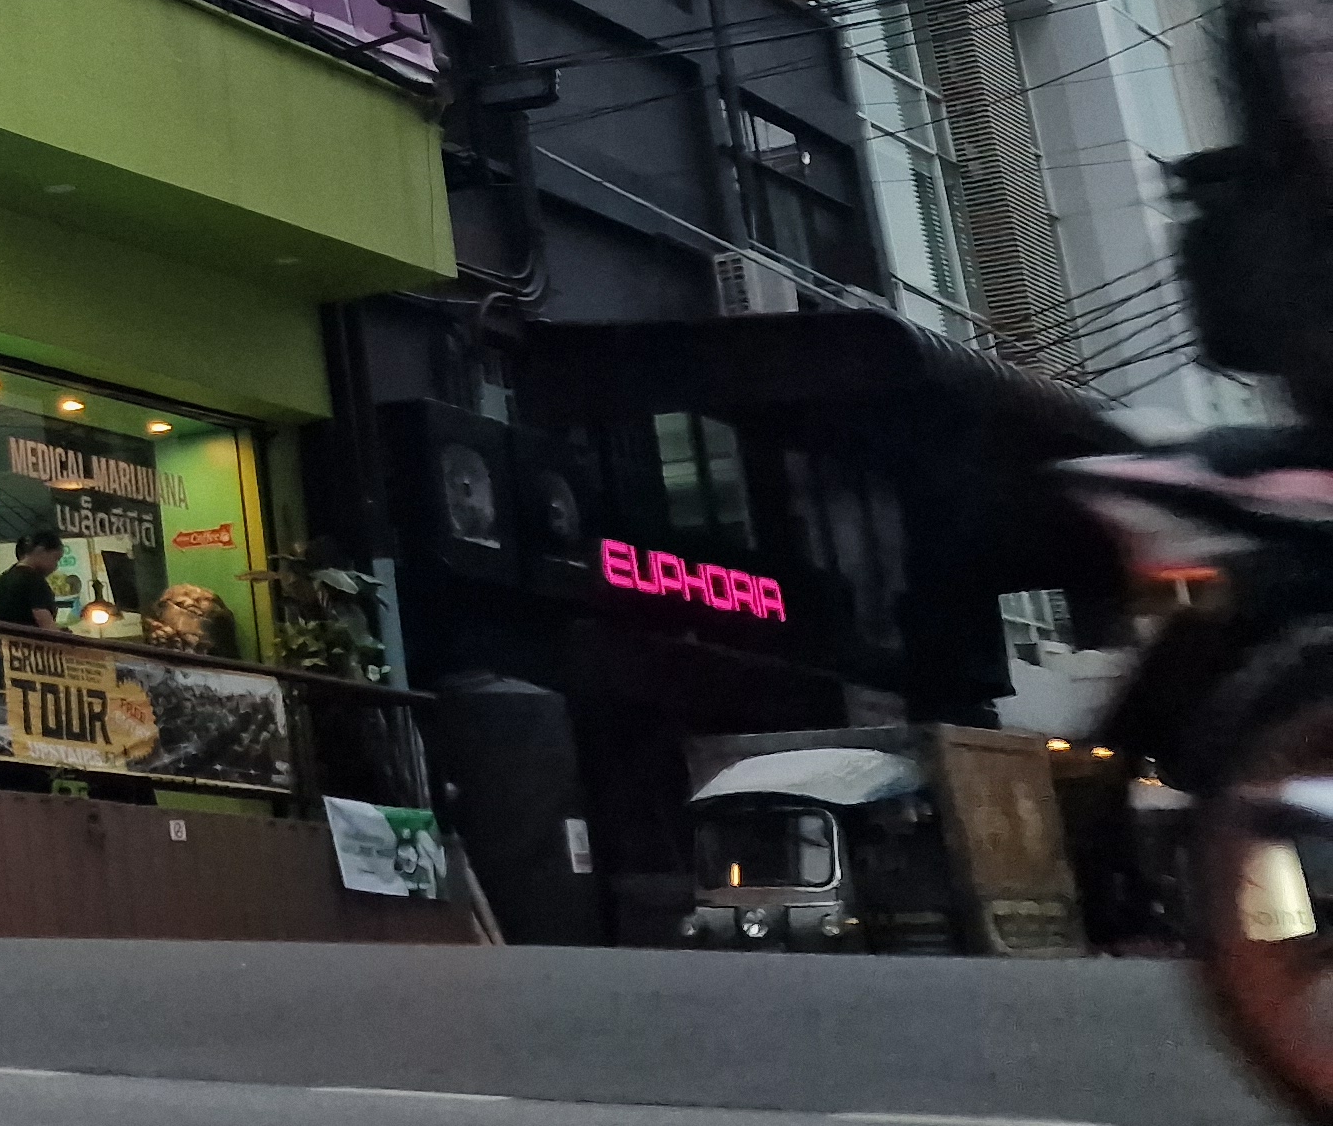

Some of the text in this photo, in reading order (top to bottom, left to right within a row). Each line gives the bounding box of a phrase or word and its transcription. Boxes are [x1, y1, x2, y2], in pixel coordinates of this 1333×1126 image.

[9, 436, 189, 510] MEDICAL MARIJUANA
[602, 538, 787, 622] EUPHORIA
[11, 677, 113, 746] TOUR
